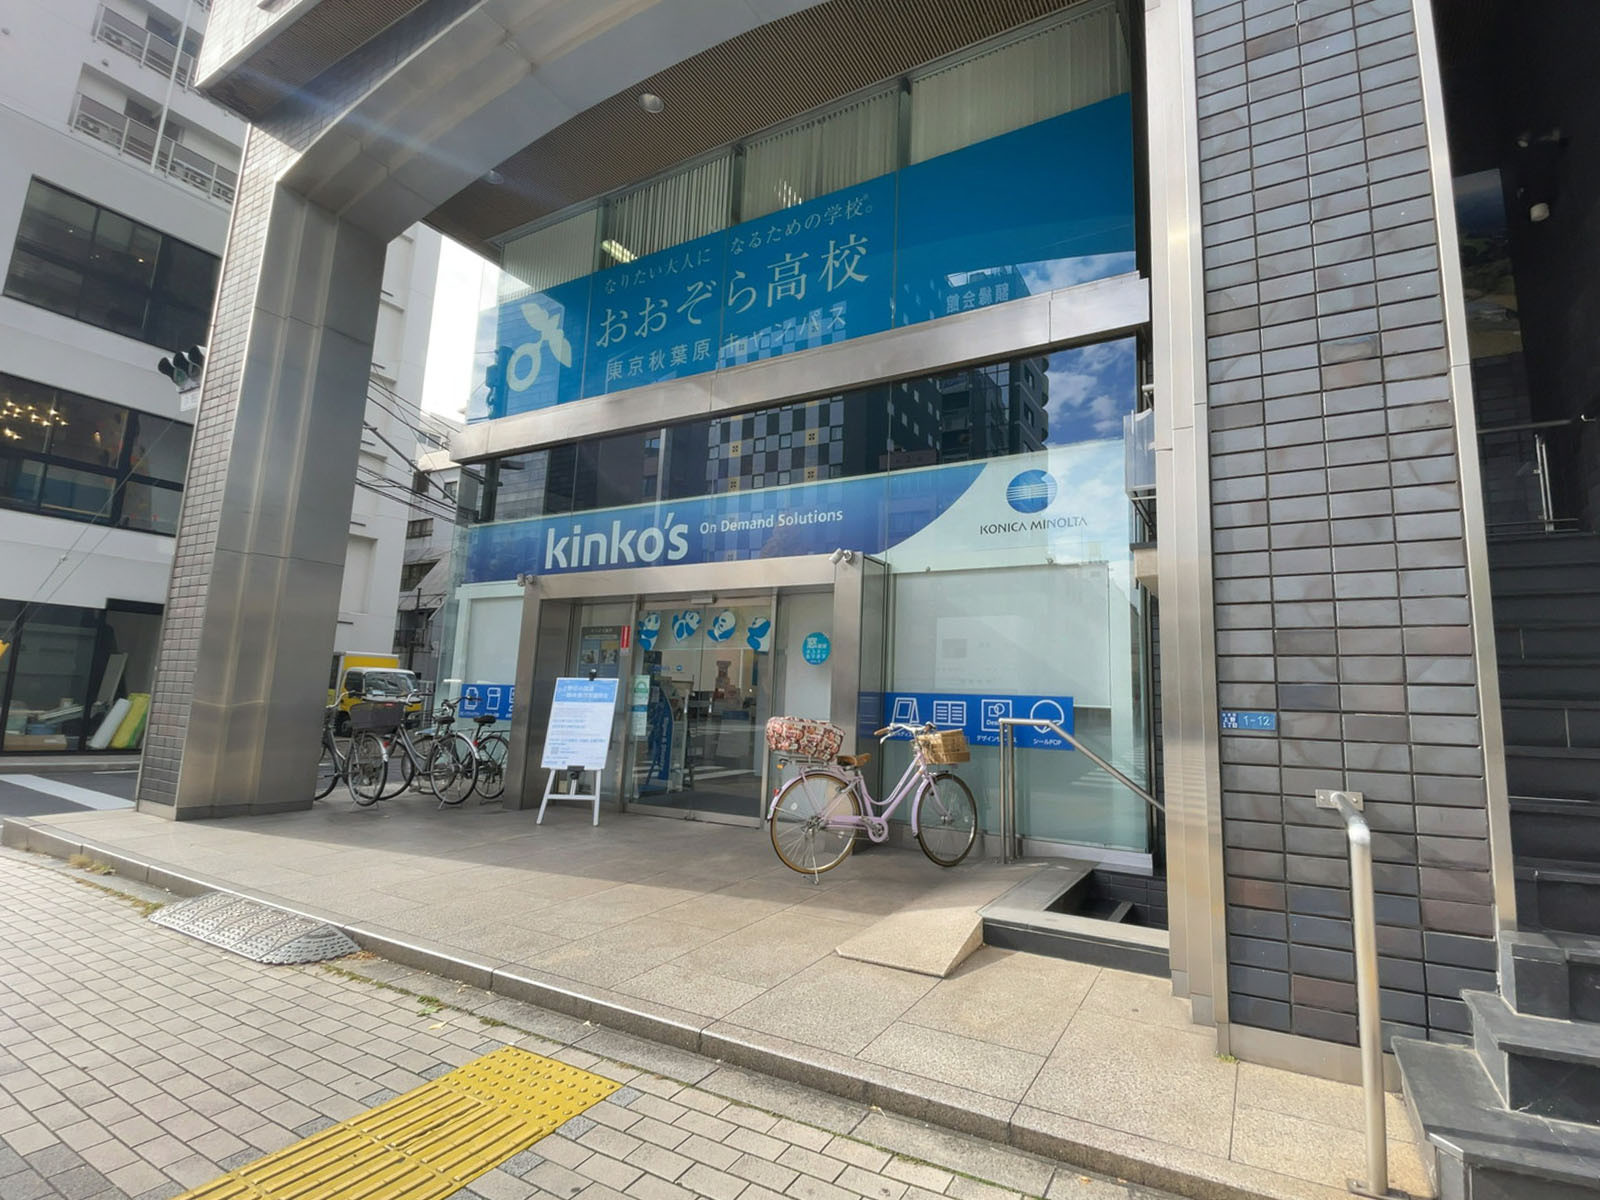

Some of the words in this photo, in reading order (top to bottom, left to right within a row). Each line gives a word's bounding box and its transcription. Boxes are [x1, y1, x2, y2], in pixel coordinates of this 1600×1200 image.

[604, 248, 711, 296] なりたい大人に
[595, 233, 870, 349] おおぞら高校
[606, 338, 712, 382] 東京秋葉原
[720, 305, 847, 353] キャンパス
[700, 521, 717, 535] On
[721, 516, 774, 533] Demand
[778, 508, 844, 528] Solutions
[980, 521, 1027, 535] KONICA
[1030, 516, 1088, 531] MINOLTA
[1243, 715, 1271, 727] 1-12
